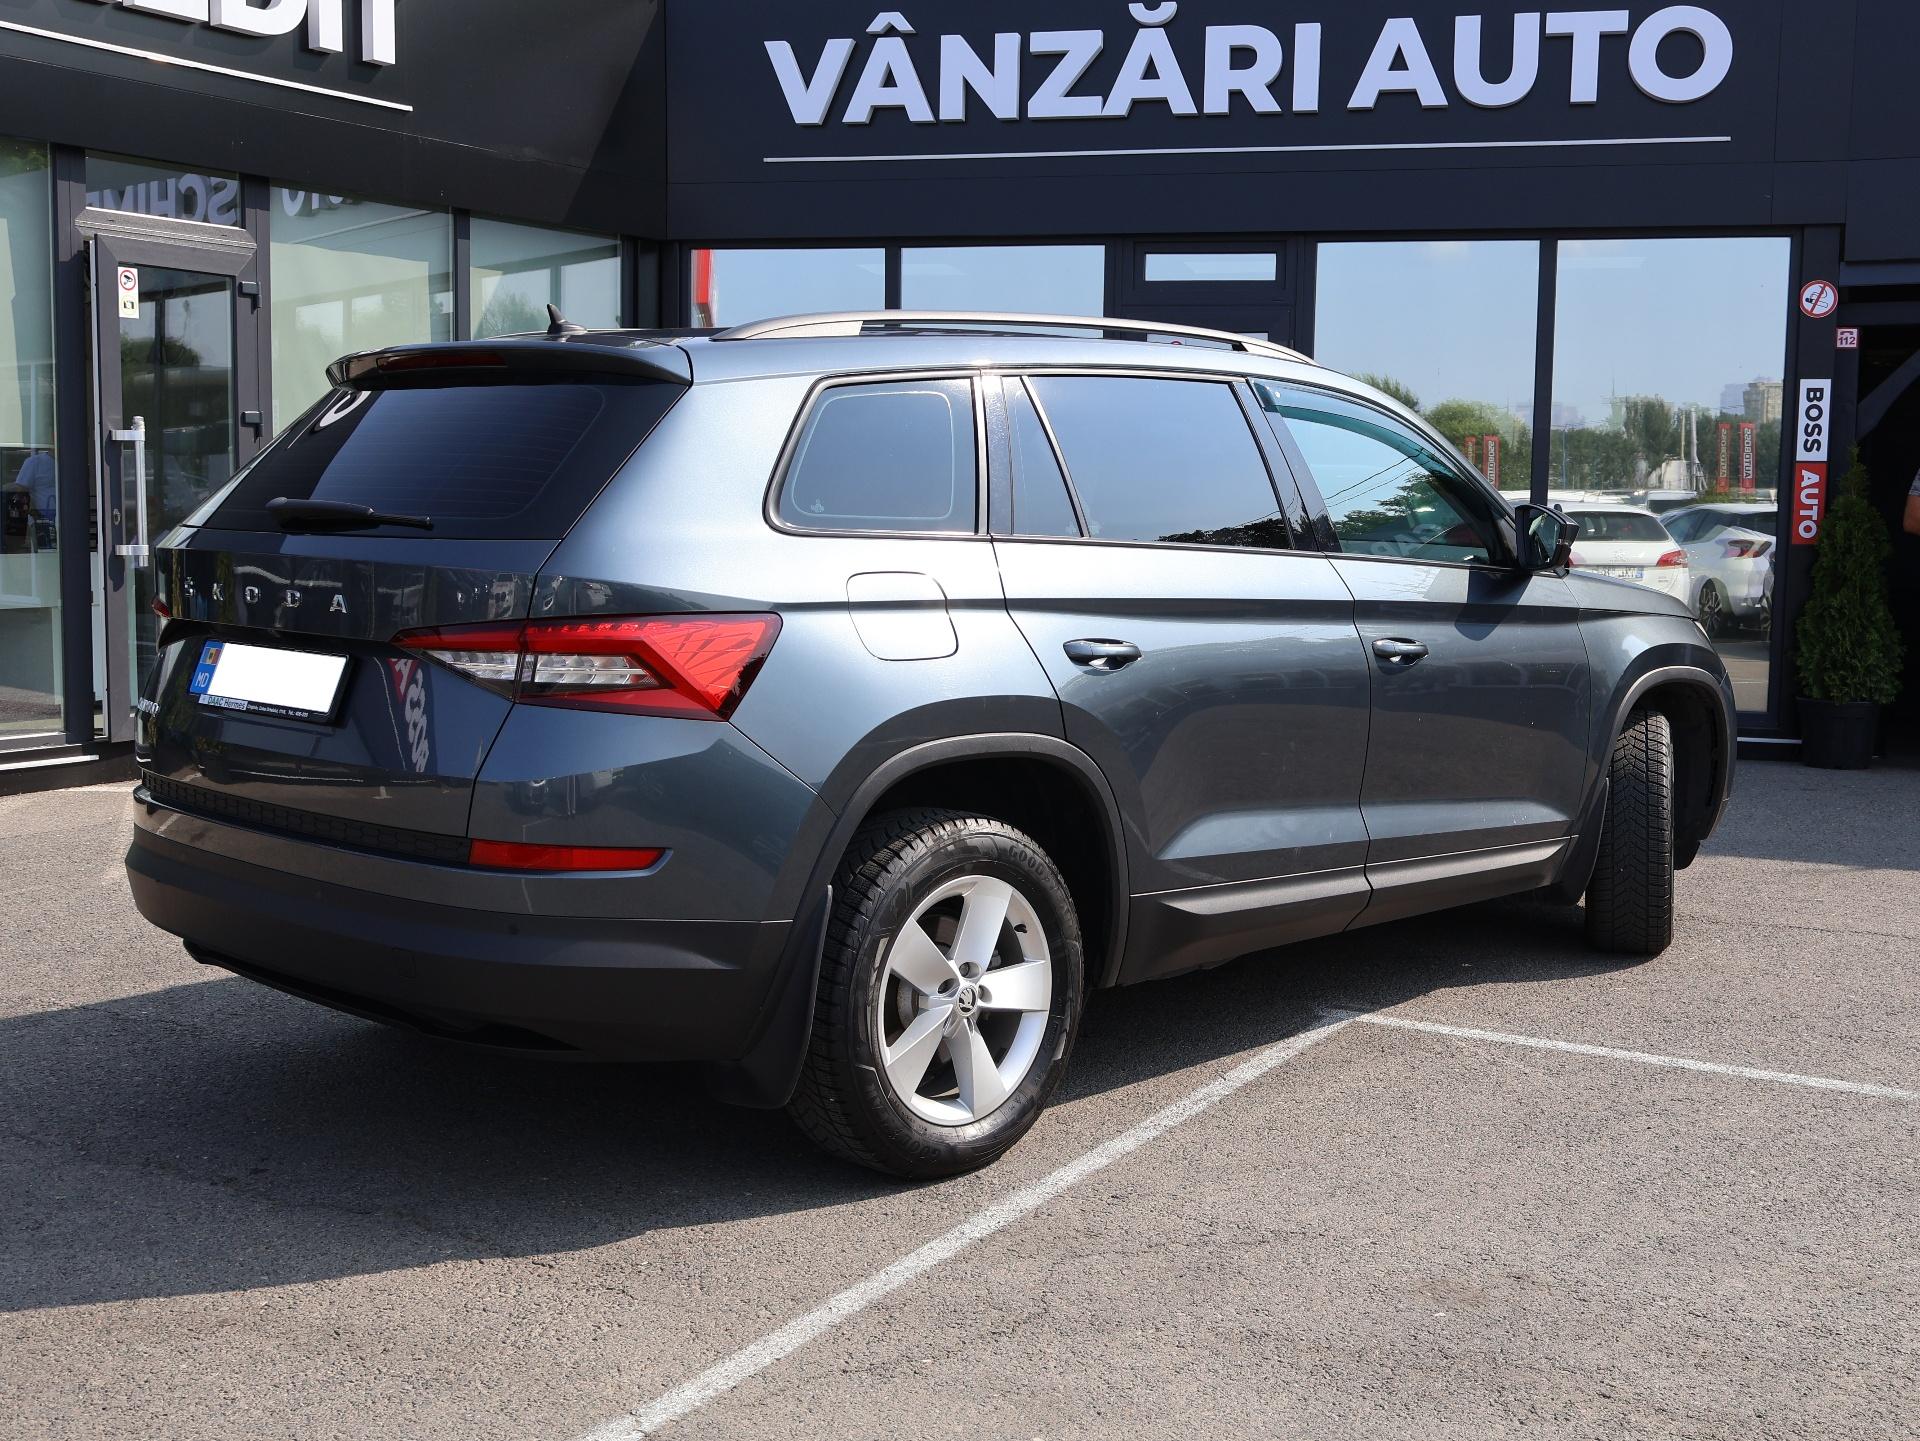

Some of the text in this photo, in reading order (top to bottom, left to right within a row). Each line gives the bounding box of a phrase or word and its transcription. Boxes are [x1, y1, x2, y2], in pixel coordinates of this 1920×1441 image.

[764, 1, 1734, 125] VÂNZĂRI AUTO
[1838, 336, 1856, 346] 112
[1798, 387, 1825, 539] BOSS AUTO
[195, 671, 210, 688] MD
